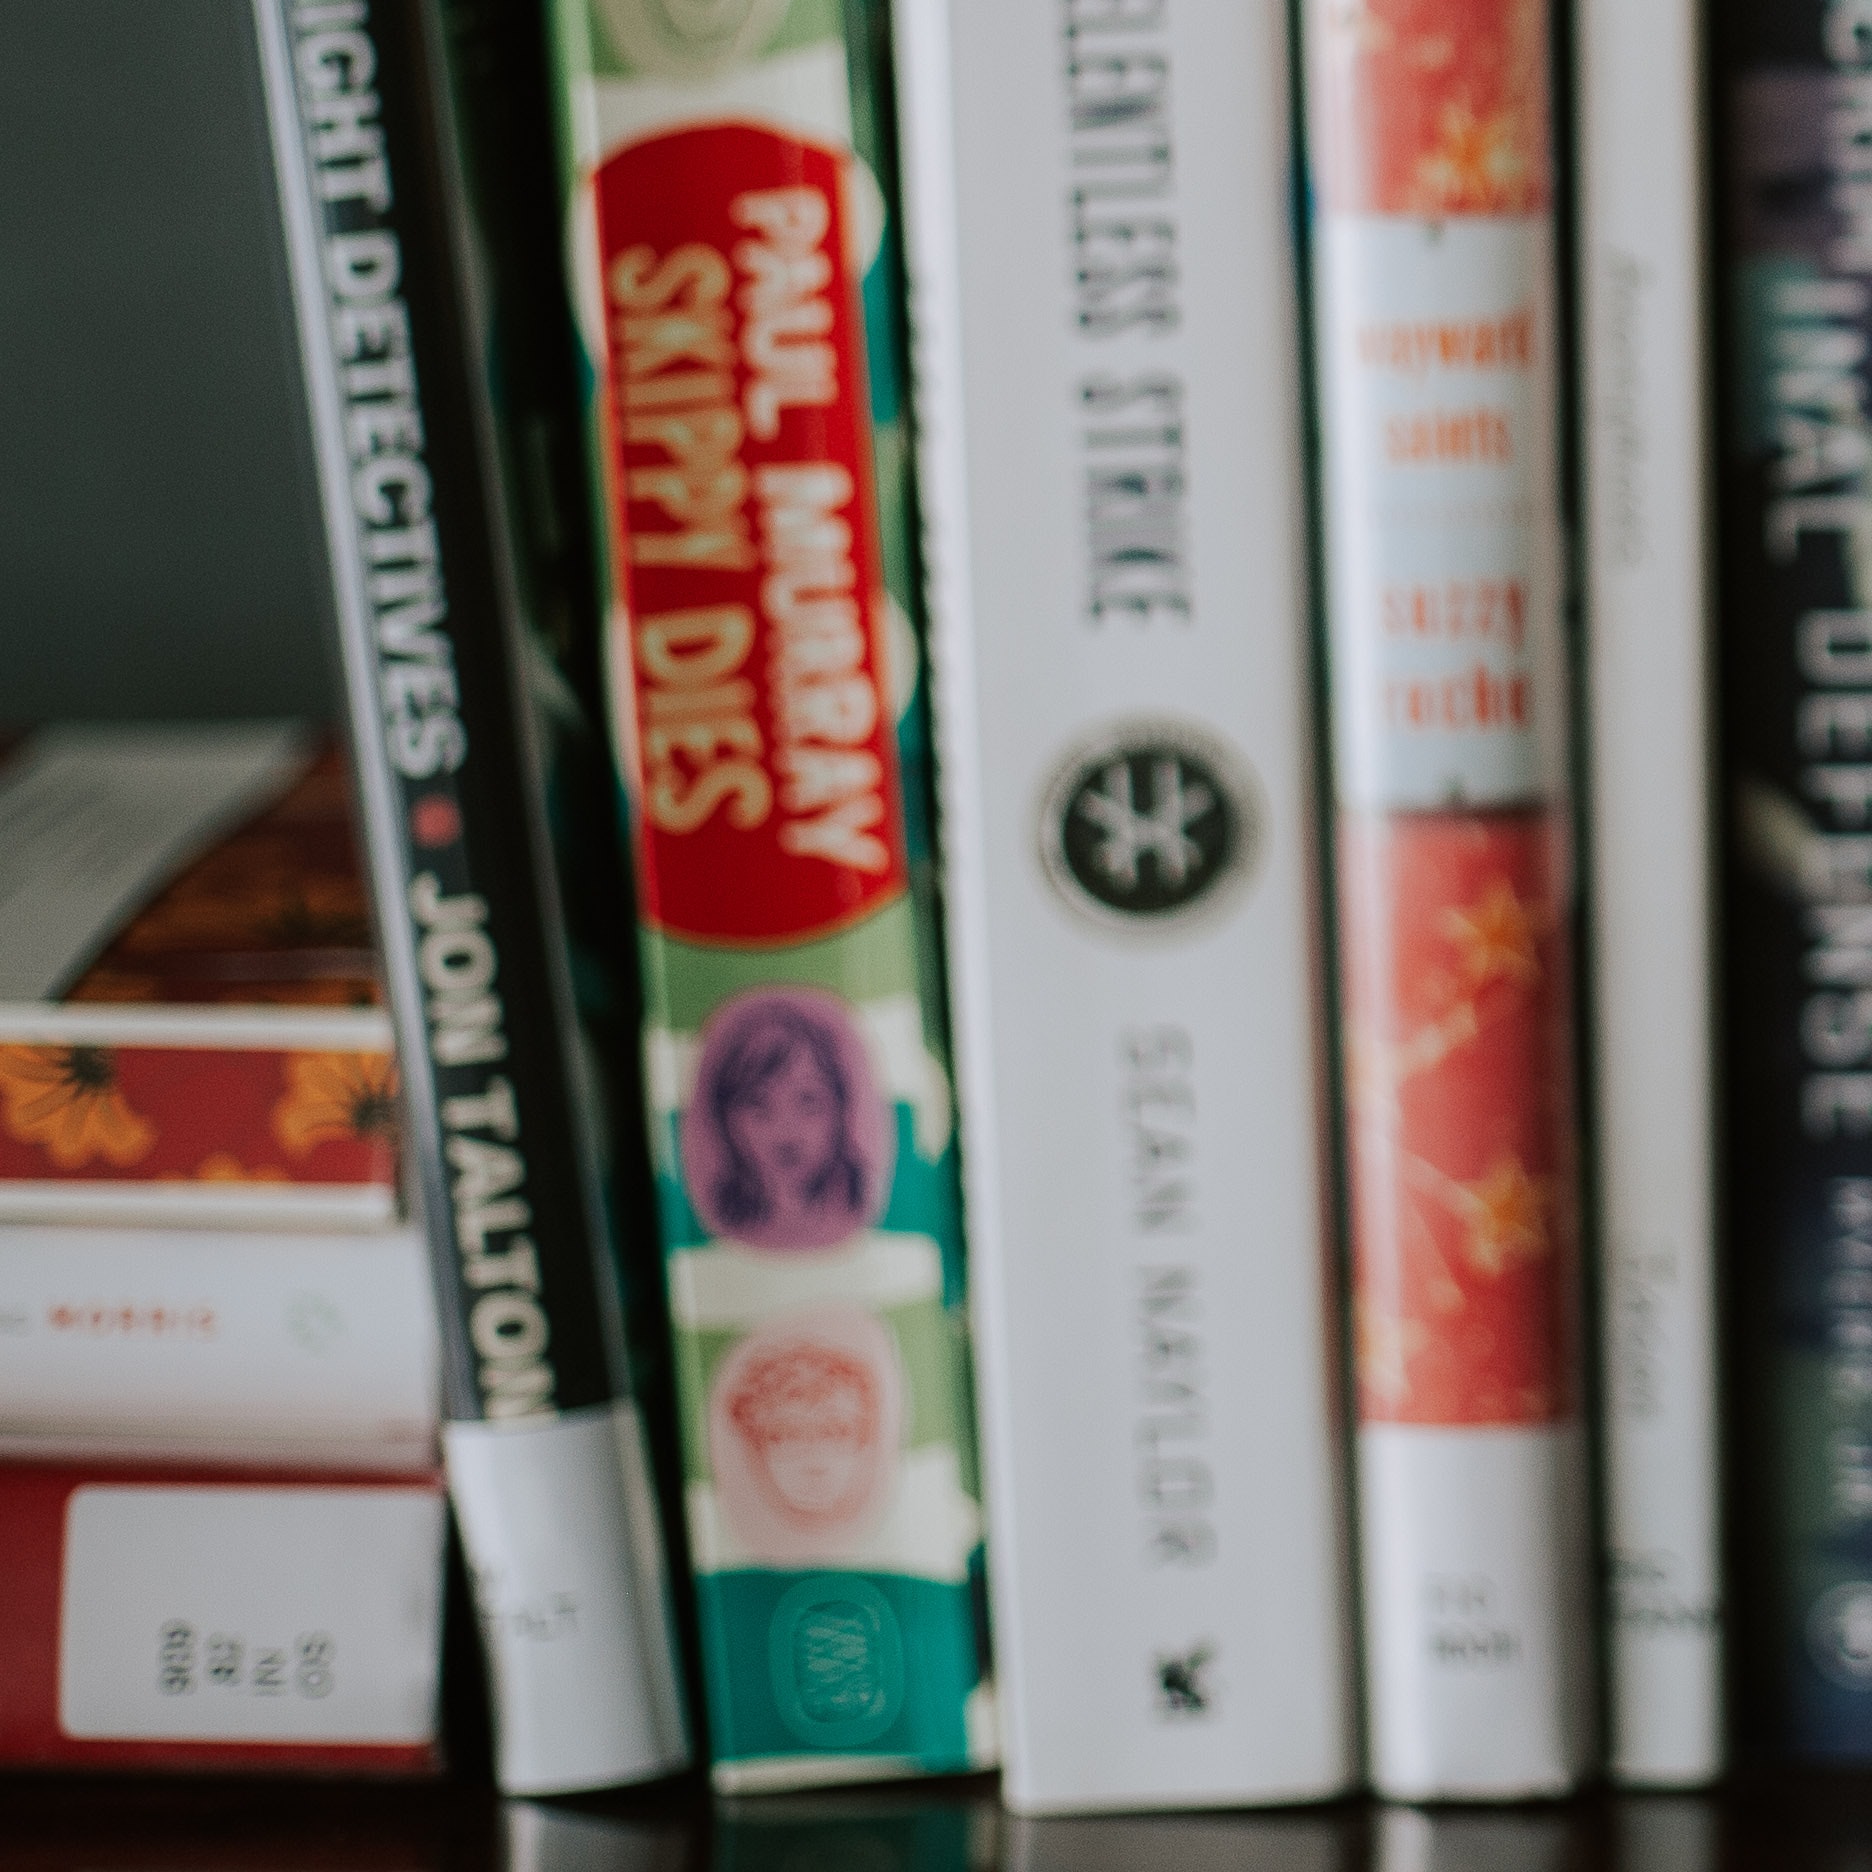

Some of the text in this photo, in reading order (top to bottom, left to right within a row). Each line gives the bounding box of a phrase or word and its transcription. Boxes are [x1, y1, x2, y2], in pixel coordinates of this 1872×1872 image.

[324, 225, 468, 784] DETECTIVES
[608, 240, 774, 838] SKIPPY DIES
[733, 184, 890, 877] PAUL MURRAY
[1075, 371, 1193, 631] STRIKE
[1383, 407, 1513, 465] saints
[406, 870, 509, 1065] JON
[442, 1078, 560, 1430] TALTON
[1114, 1020, 1221, 1571] SEAN NAYLOR
